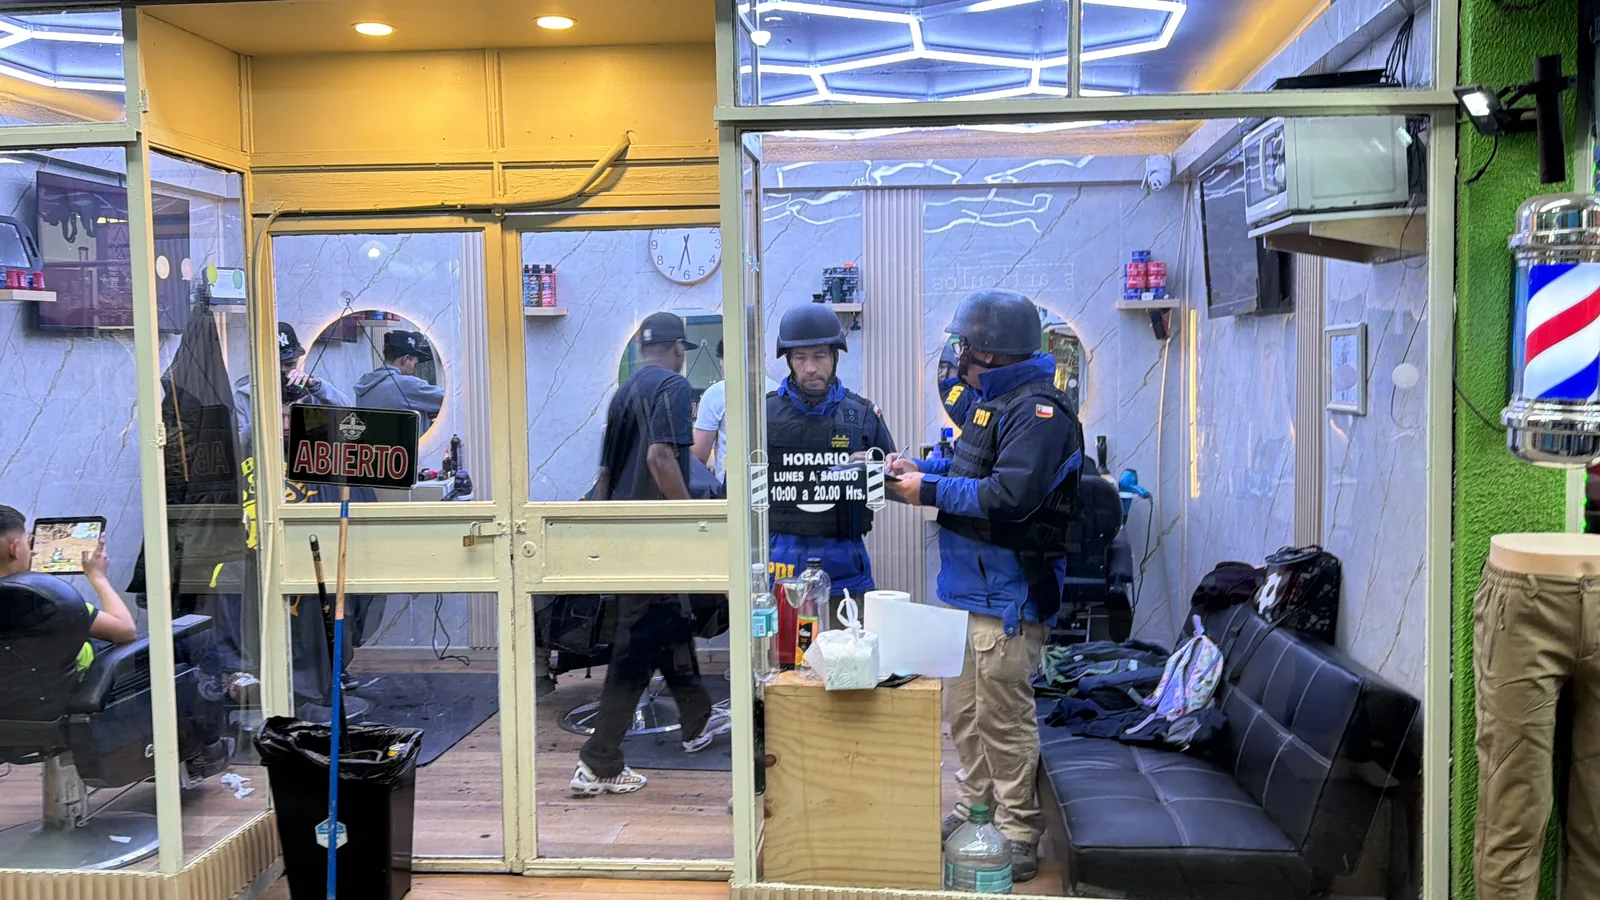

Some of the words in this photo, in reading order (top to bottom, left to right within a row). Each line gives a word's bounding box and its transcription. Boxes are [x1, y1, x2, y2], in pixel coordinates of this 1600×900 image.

[651, 240, 658, 250] 9
[715, 239, 721, 249] 3
[657, 255, 664, 266] 8
[709, 254, 716, 265] 4
[668, 266, 675, 276] 7
[683, 270, 691, 280] 6
[698, 266, 705, 276] 5
[973, 408, 991, 426] PDI
[293, 440, 409, 479] ABIERTO
[783, 452, 849, 466] HORARIO
[774, 471, 804, 482] LUNES
[809, 472, 816, 482] A
[820, 470, 859, 482] SABADO
[770, 486, 797, 501] 10:00
[802, 489, 809, 500] a
[814, 486, 841, 501] 20.00
[846, 485, 866, 500] Hrs.
